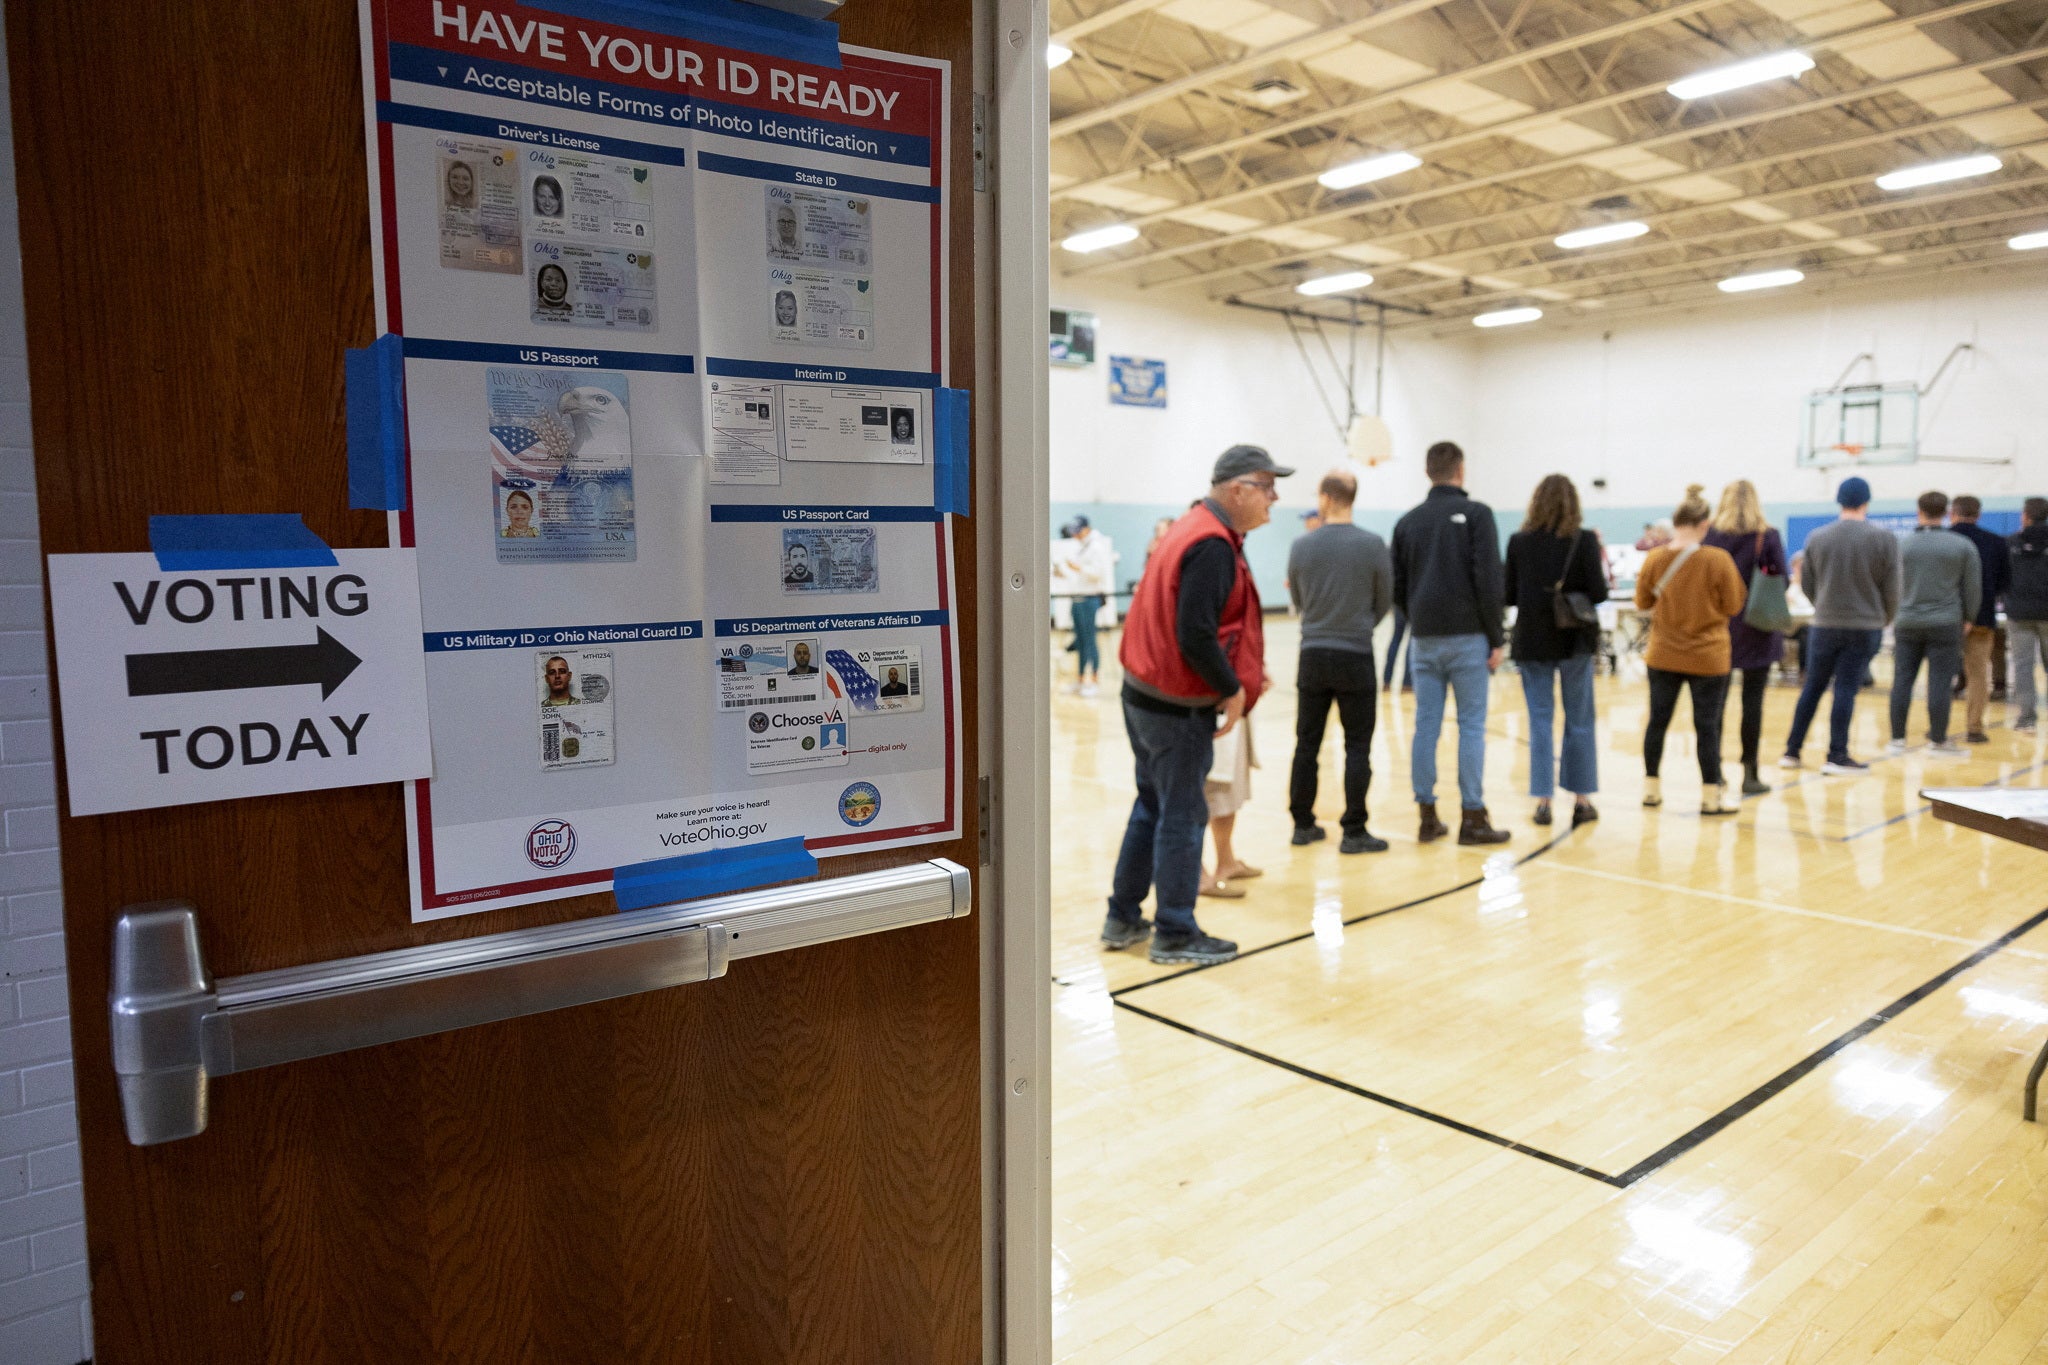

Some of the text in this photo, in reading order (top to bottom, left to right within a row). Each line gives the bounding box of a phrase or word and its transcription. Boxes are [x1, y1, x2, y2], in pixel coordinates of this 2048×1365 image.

[432, 1, 900, 120] HAVE YOUR ID READY
[463, 67, 878, 154] Acceptable Forms of Photo Identification
[552, 133, 600, 151] License
[530, 151, 554, 164] Ohio
[795, 172, 837, 187] State ID
[771, 188, 791, 199] Ohio
[534, 242, 559, 255] Ohio
[771, 269, 792, 281] Ohio
[520, 350, 599, 367] US Passport
[795, 368, 847, 381] Interim ID
[782, 509, 870, 522] US Passport Card
[605, 532, 626, 541] USA
[113, 574, 369, 626] VOTING
[733, 615, 922, 635] US Department of Veterans Affairs ID
[443, 626, 693, 648] US Military ID or Ohio National Guard ID
[721, 648, 734, 657] VA
[541, 707, 559, 715] DOE,
[541, 713, 561, 721] JOHN
[139, 713, 370, 774] TODAY
[868, 742, 908, 753] digital only
[656, 799, 770, 820] Make sure your voice is heard!
[687, 813, 742, 827] Learn more at:
[538, 833, 562, 846] OHIO
[660, 822, 768, 847] VoteOhio.gov
[533, 845, 560, 858] VOTED
[445, 895, 460, 903] SOS
